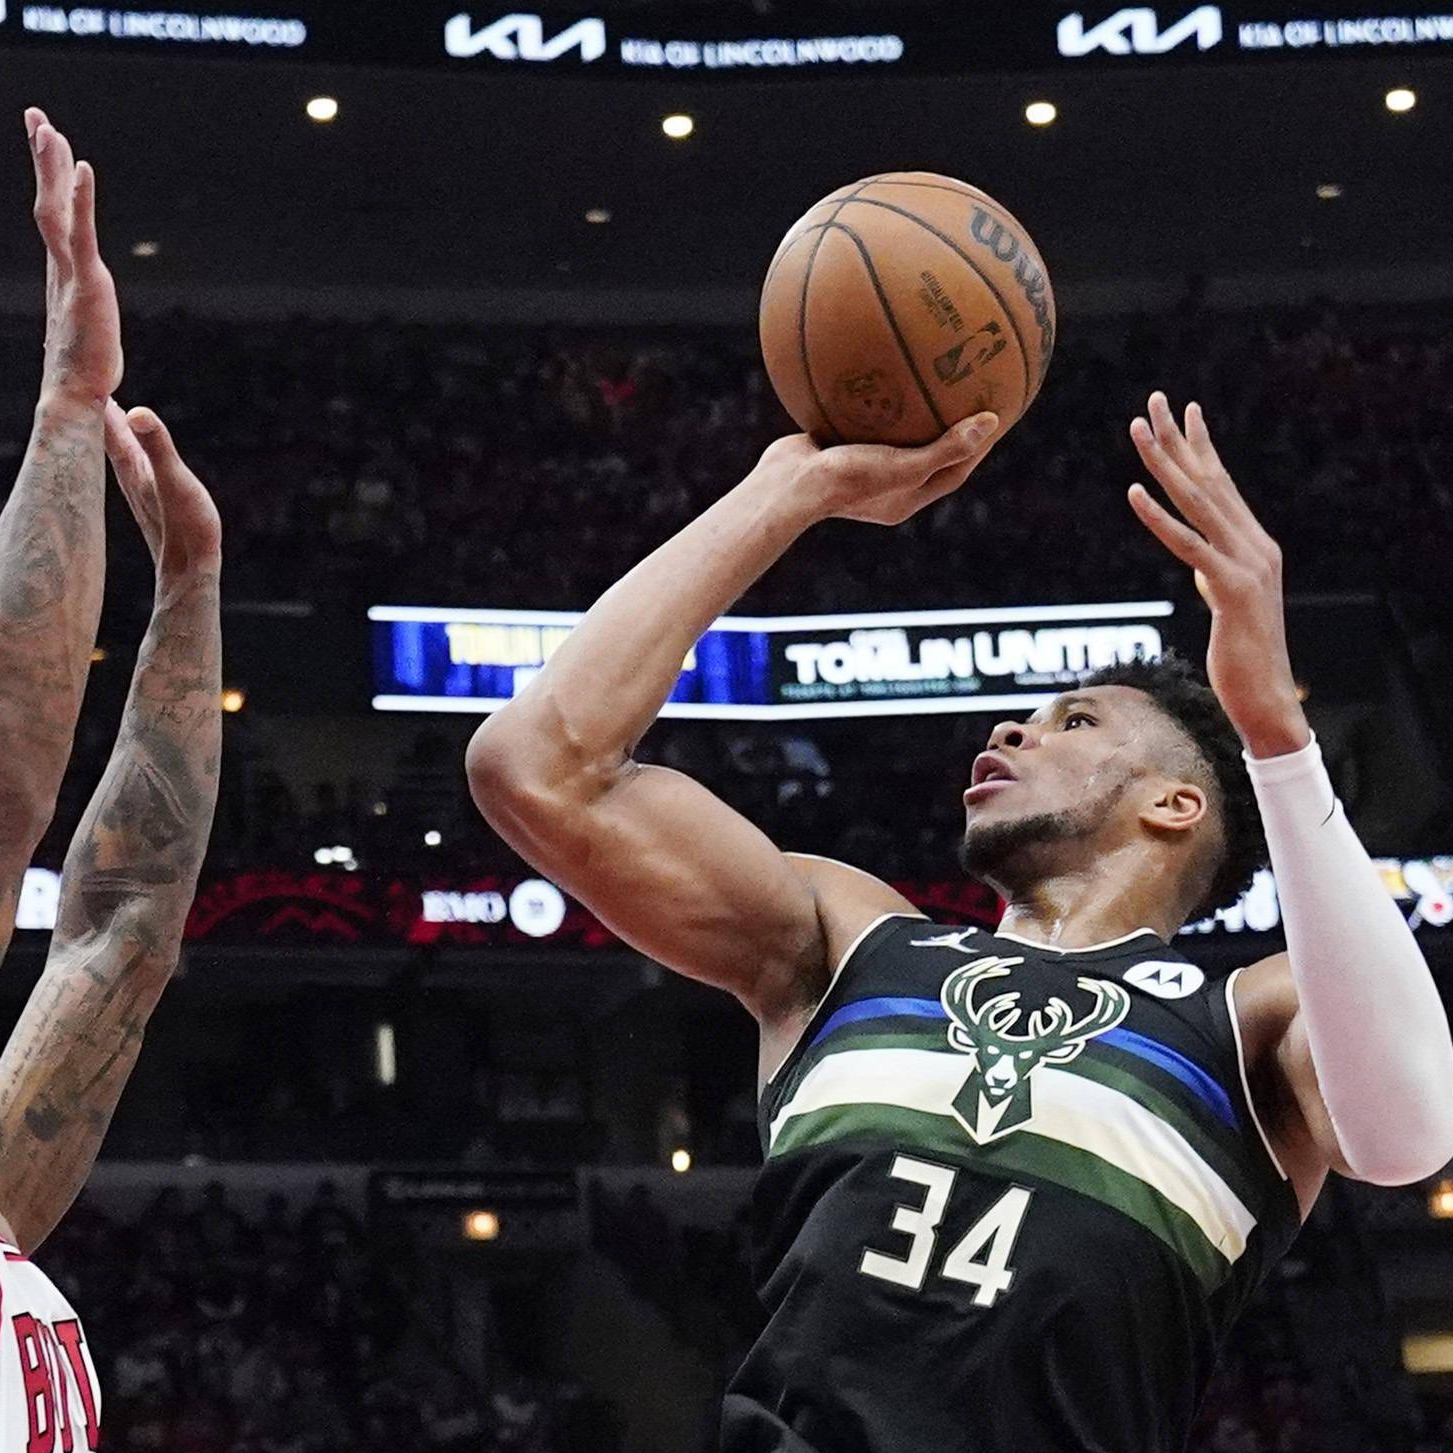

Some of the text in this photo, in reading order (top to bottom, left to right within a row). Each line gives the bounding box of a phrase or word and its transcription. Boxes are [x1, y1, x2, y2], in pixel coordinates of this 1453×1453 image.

[444, 13, 606, 62] KIA
[1057, 5, 1223, 57] KIA
[857, 1151, 1037, 1309] 34
